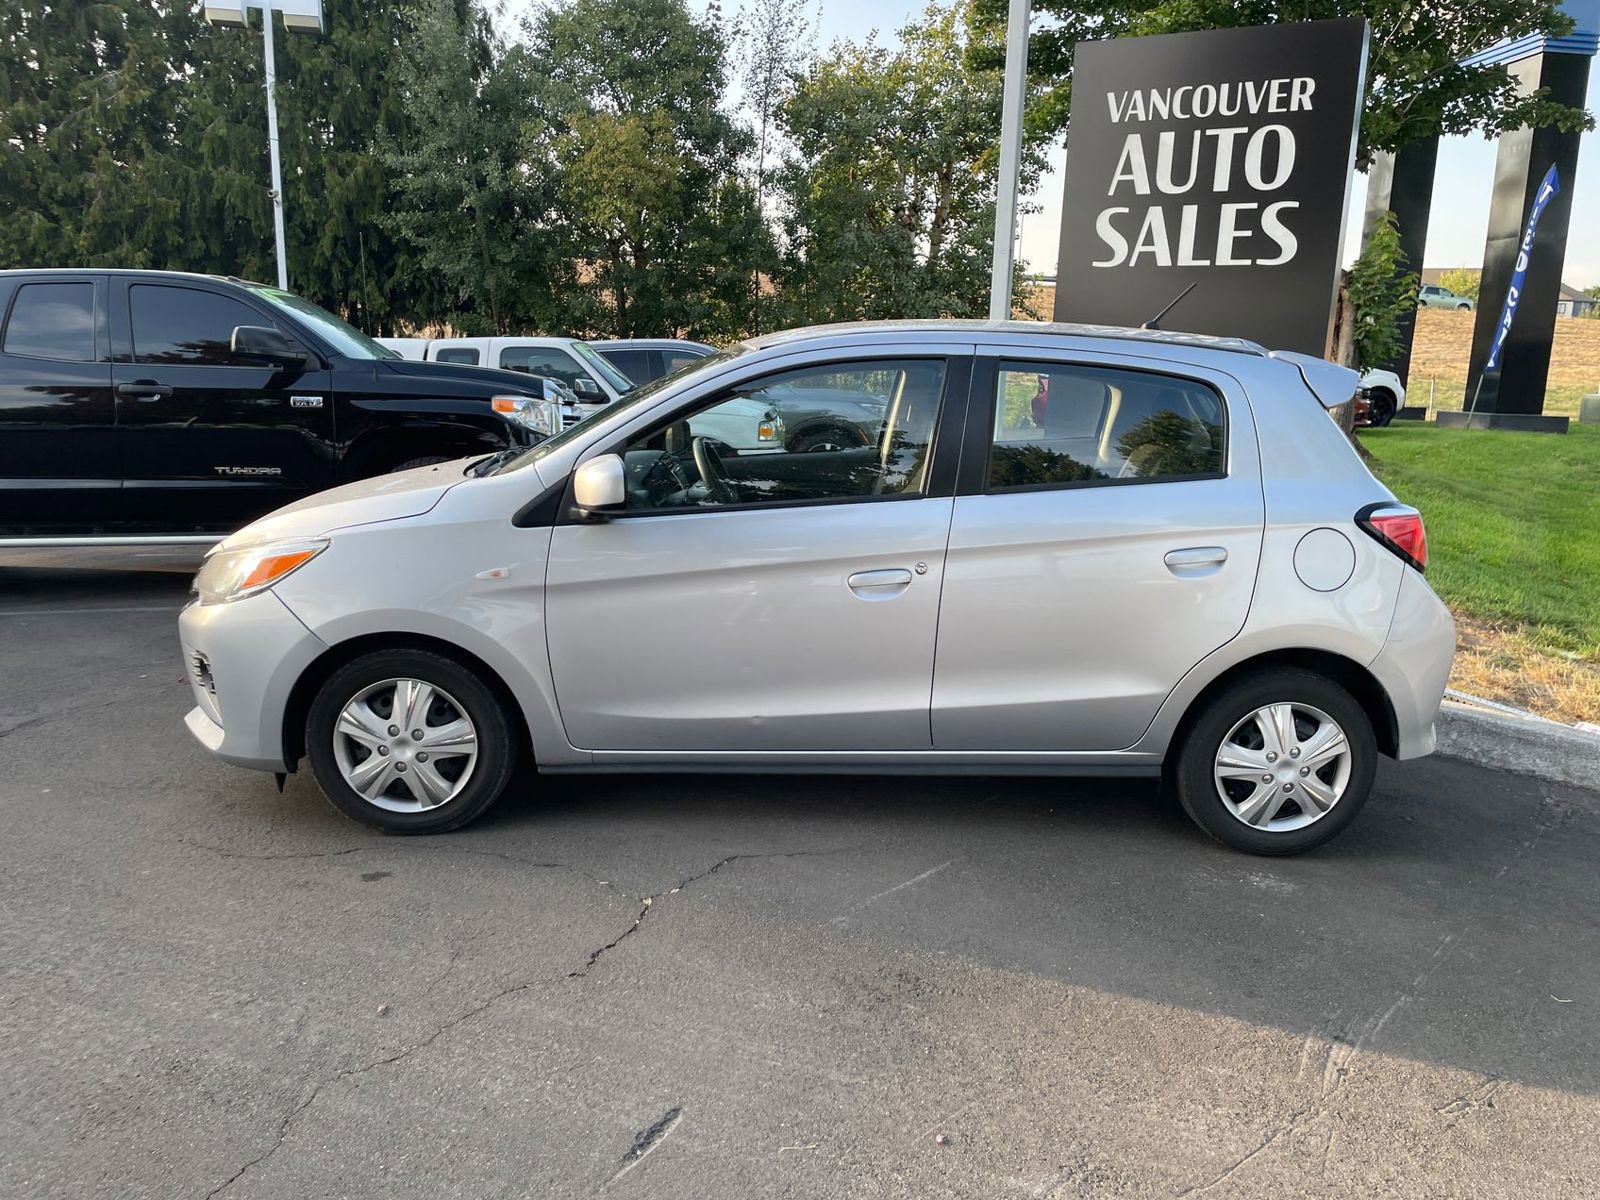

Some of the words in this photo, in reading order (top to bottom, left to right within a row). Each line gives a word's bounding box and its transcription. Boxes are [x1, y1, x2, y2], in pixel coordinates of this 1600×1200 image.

[1107, 78, 1316, 124] VANCOUVER
[1108, 125, 1296, 197] AUTO
[1092, 201, 1300, 268] SALES
[214, 466, 282, 476] TUNDRA
